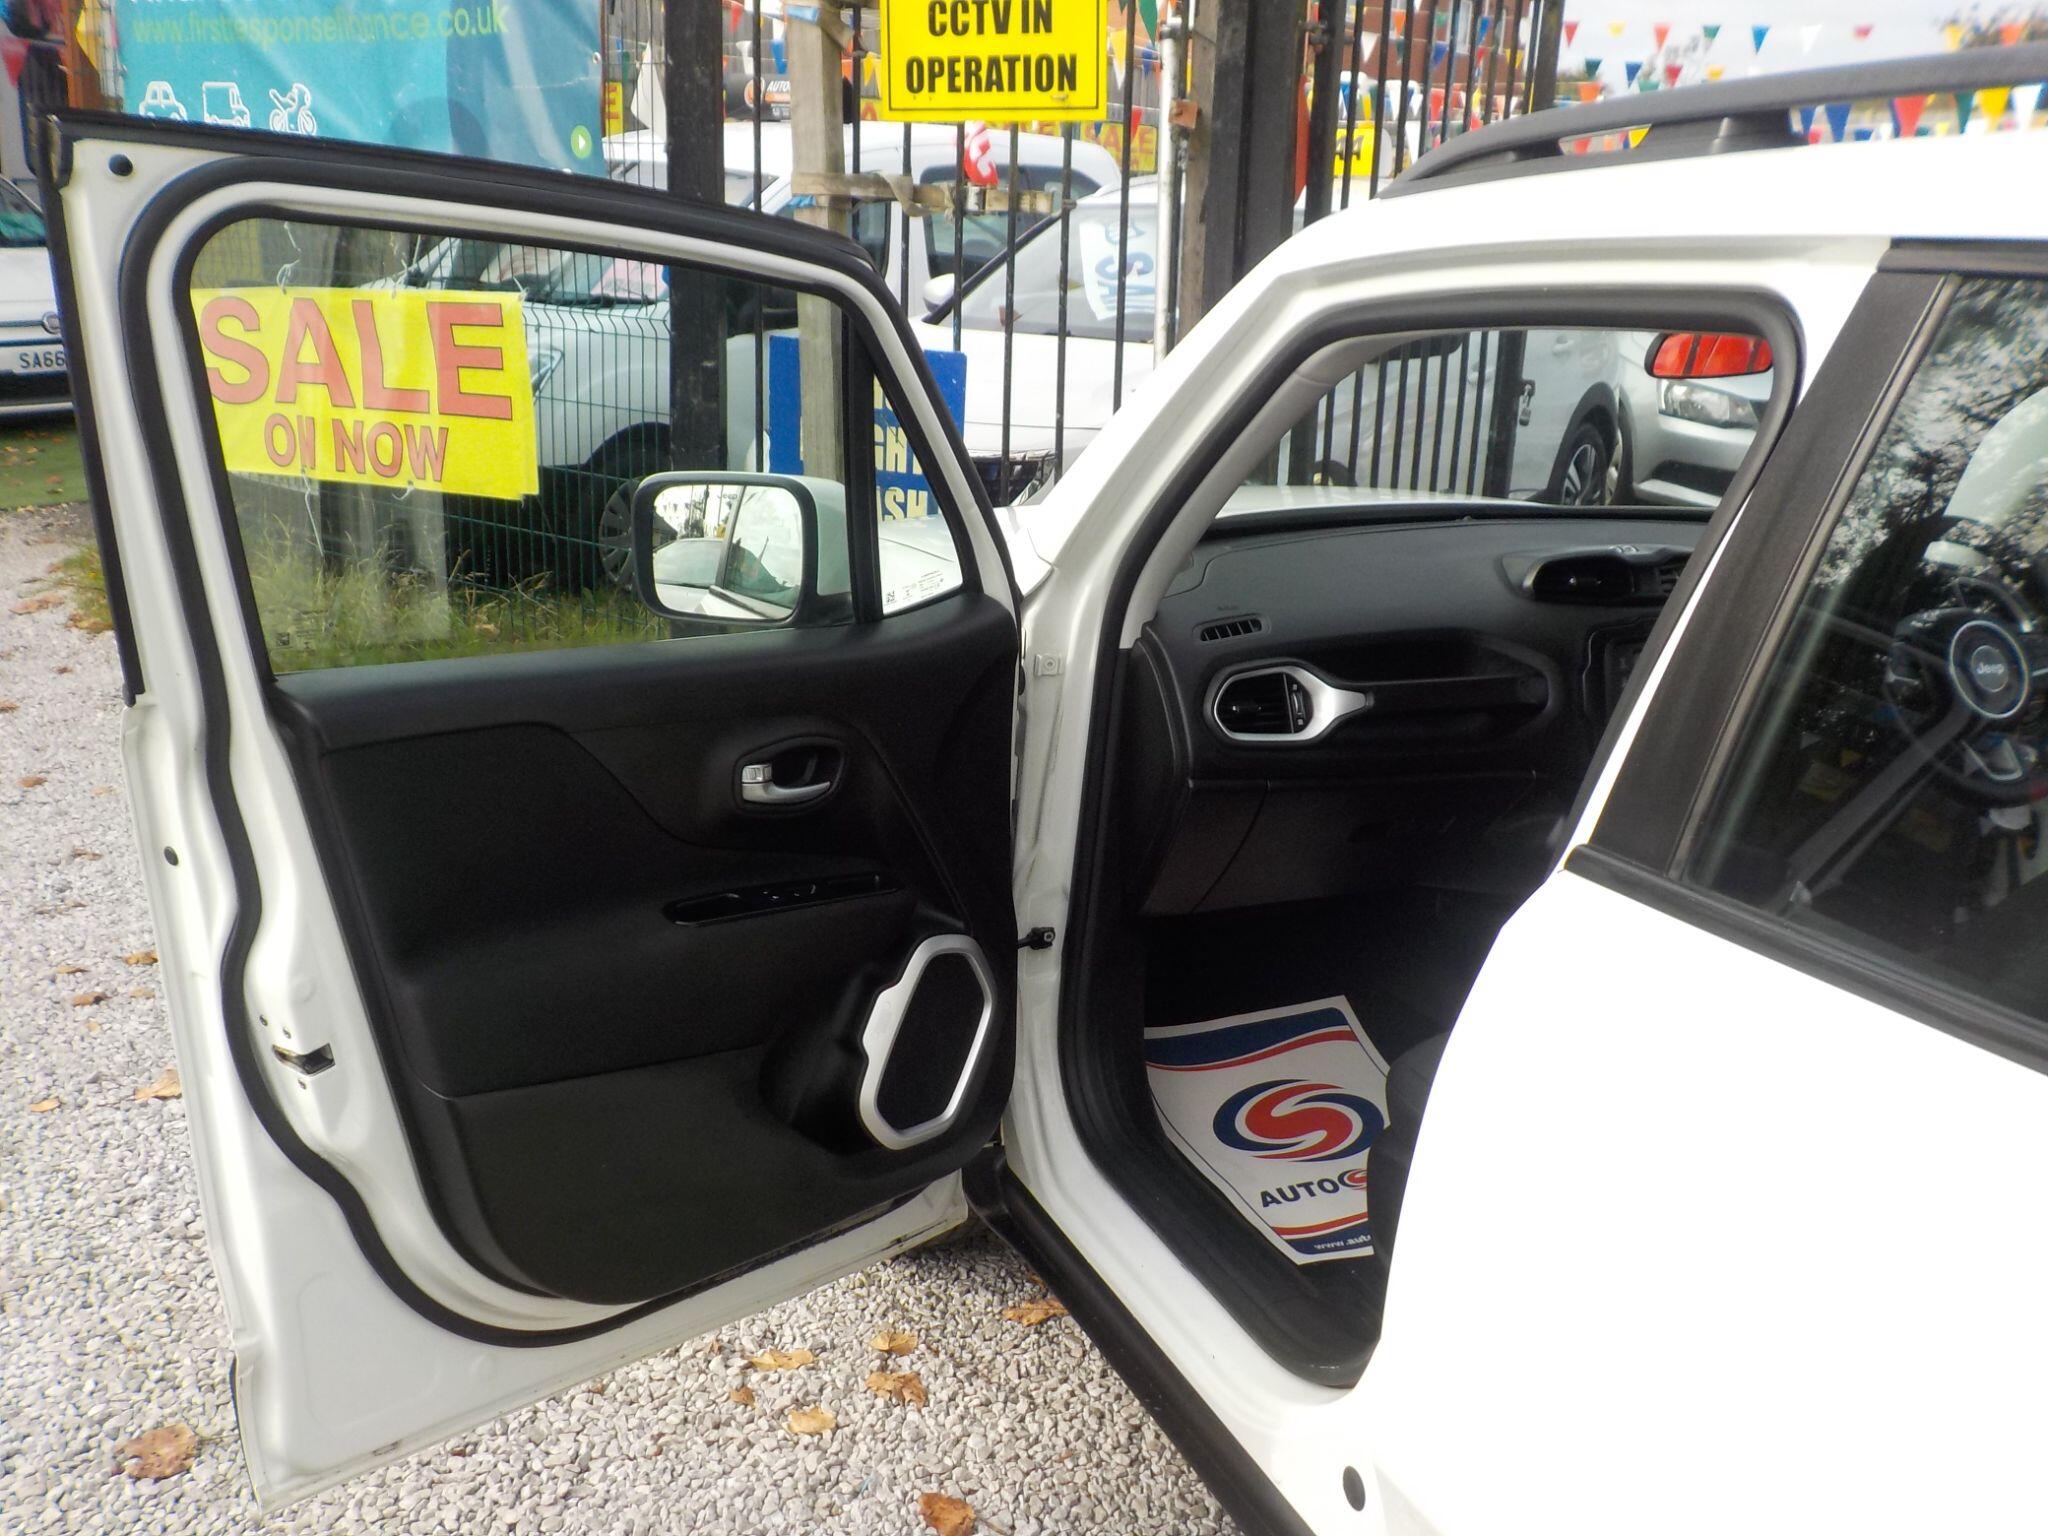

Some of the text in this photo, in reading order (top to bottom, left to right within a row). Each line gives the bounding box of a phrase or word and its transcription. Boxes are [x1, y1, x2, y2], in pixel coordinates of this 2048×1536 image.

[928, 0, 1053, 37] CCTV IN
[906, 54, 1077, 94] OPERATION
[19, 351, 65, 369] SA66
[200, 295, 513, 421] SALE
[264, 413, 449, 482] ON NOW
[1976, 662, 2005, 675] Jeep
